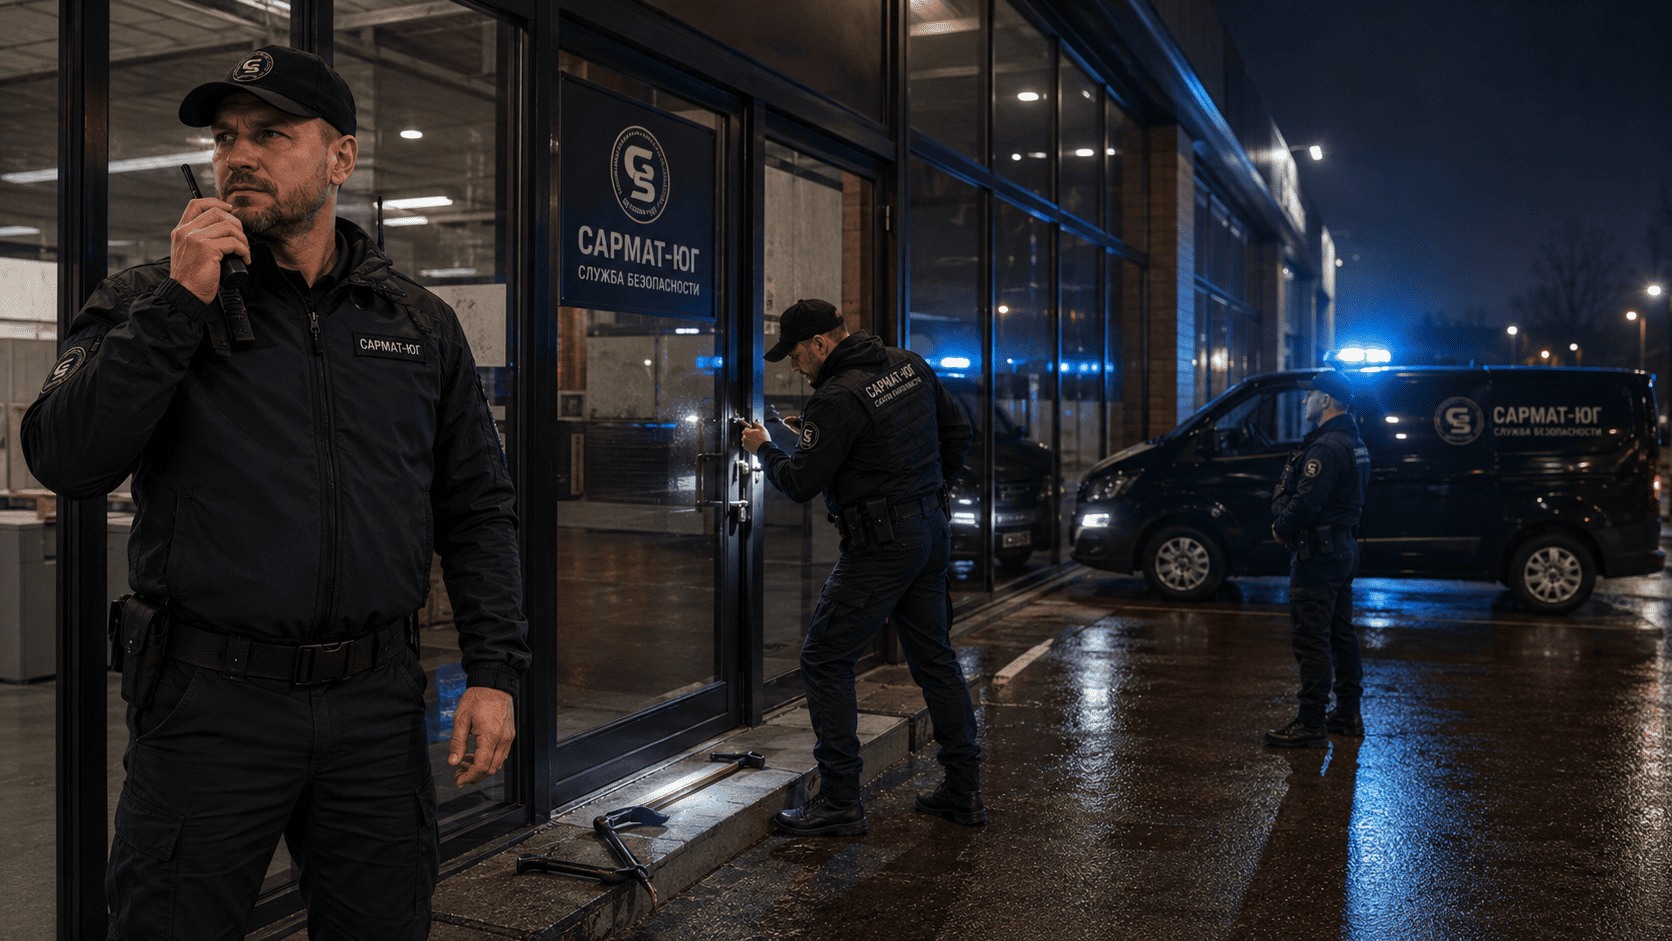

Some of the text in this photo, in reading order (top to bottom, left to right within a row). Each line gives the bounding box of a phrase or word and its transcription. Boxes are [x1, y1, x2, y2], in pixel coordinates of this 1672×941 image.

[578, 225, 700, 273] САРМАТ-ЮГ
[578, 265, 700, 296] СЛУЖБА БЕЗОПАСНОСТИ
[359, 338, 421, 356] САРМАТ-ЮГ
[1493, 406, 1602, 424] САРМАТ-ЮГ
[1493, 427, 1602, 437] СЛУЖБА БЕЗОПАСНОСТИ
